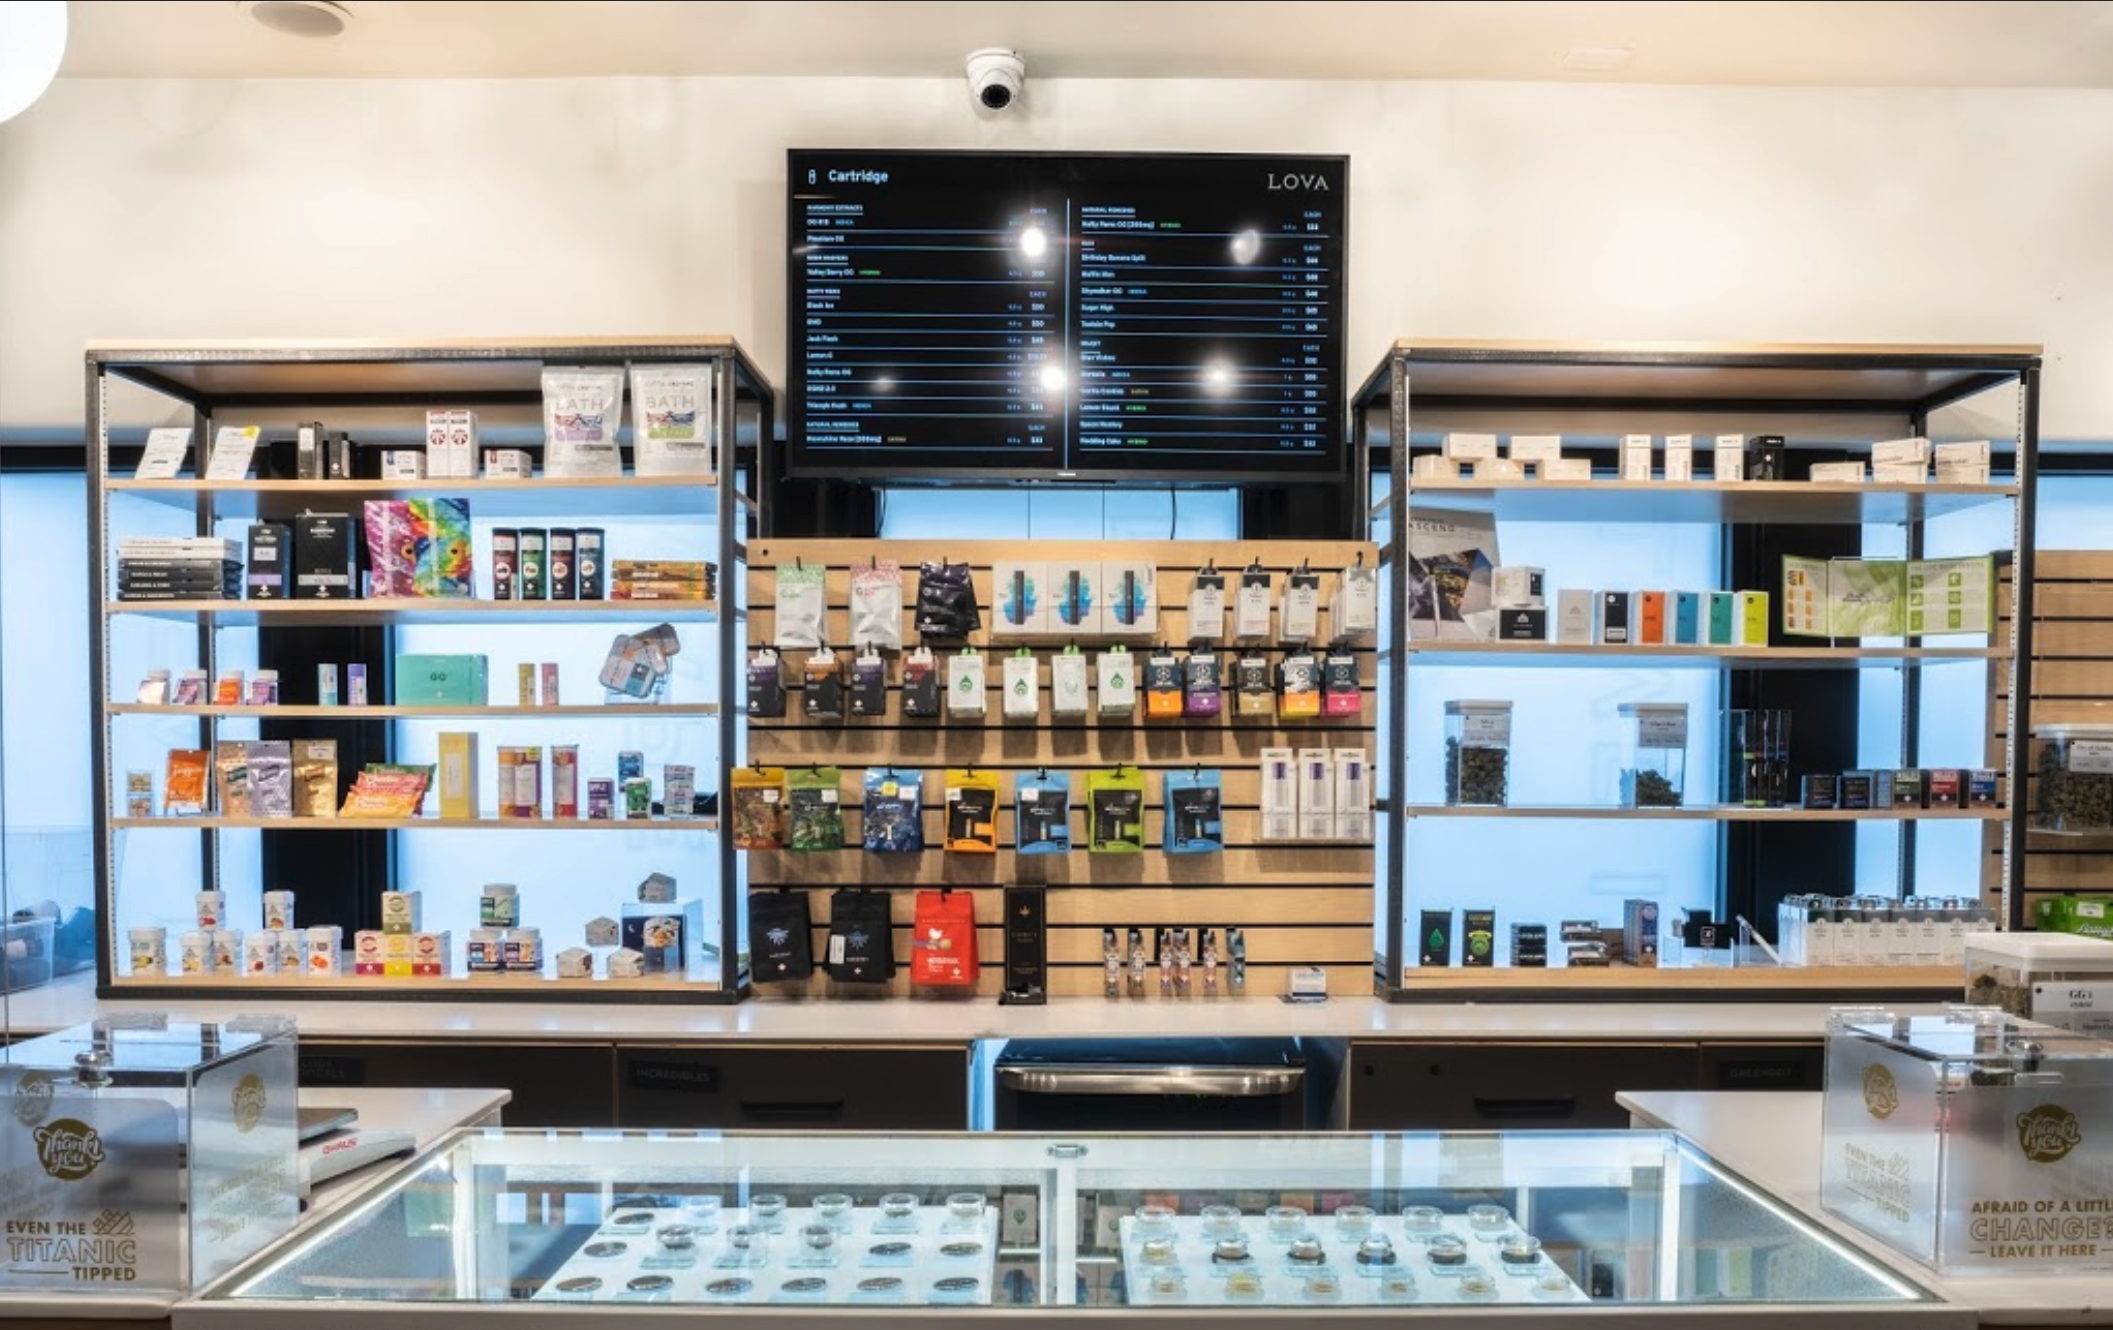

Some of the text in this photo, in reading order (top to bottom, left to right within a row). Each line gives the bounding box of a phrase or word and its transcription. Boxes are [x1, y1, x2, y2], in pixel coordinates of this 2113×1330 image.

[828, 170, 888, 184] Cartridge
[1268, 173, 1330, 190] LOVA
[646, 395, 694, 408] BATH
[430, 672, 447, 682] GO
[2018, 1115, 2080, 1145] Thank
[34, 1127, 106, 1161] Thank
[1972, 1200, 2113, 1214] AFRAID OF A LITTL
[6, 1221, 86, 1235] EVEN THE
[6, 1236, 136, 1264] TITANIC
[1990, 1244, 2096, 1258] LEAVE IT HERE
[72, 1267, 136, 1281] TIPPED
